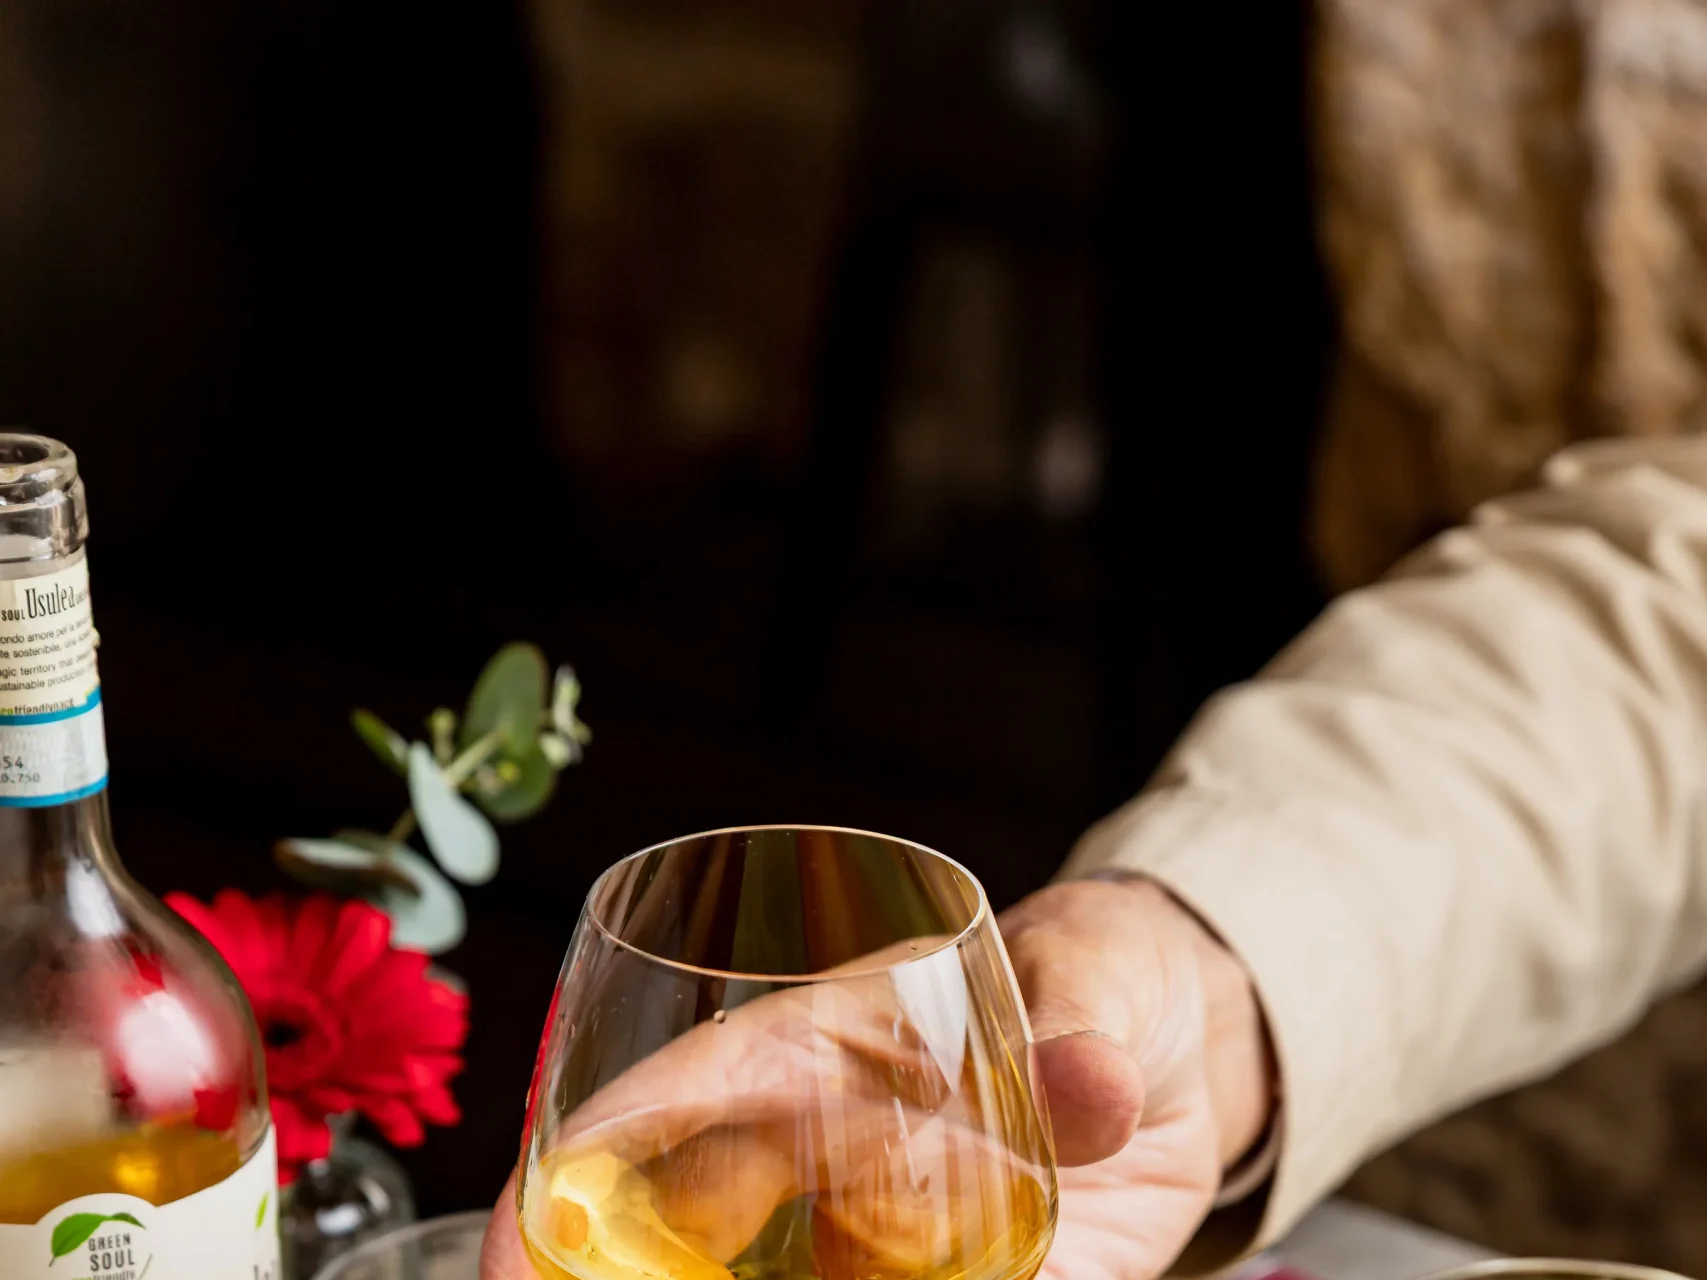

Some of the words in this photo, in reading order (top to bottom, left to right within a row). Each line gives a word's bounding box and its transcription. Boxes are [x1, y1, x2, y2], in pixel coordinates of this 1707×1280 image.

[2, 609, 26, 621] SOUL
[27, 630, 54, 642] amore
[20, 663, 56, 676] territory
[88, 1232, 131, 1251] GREEN
[89, 1249, 136, 1272] SOUL
